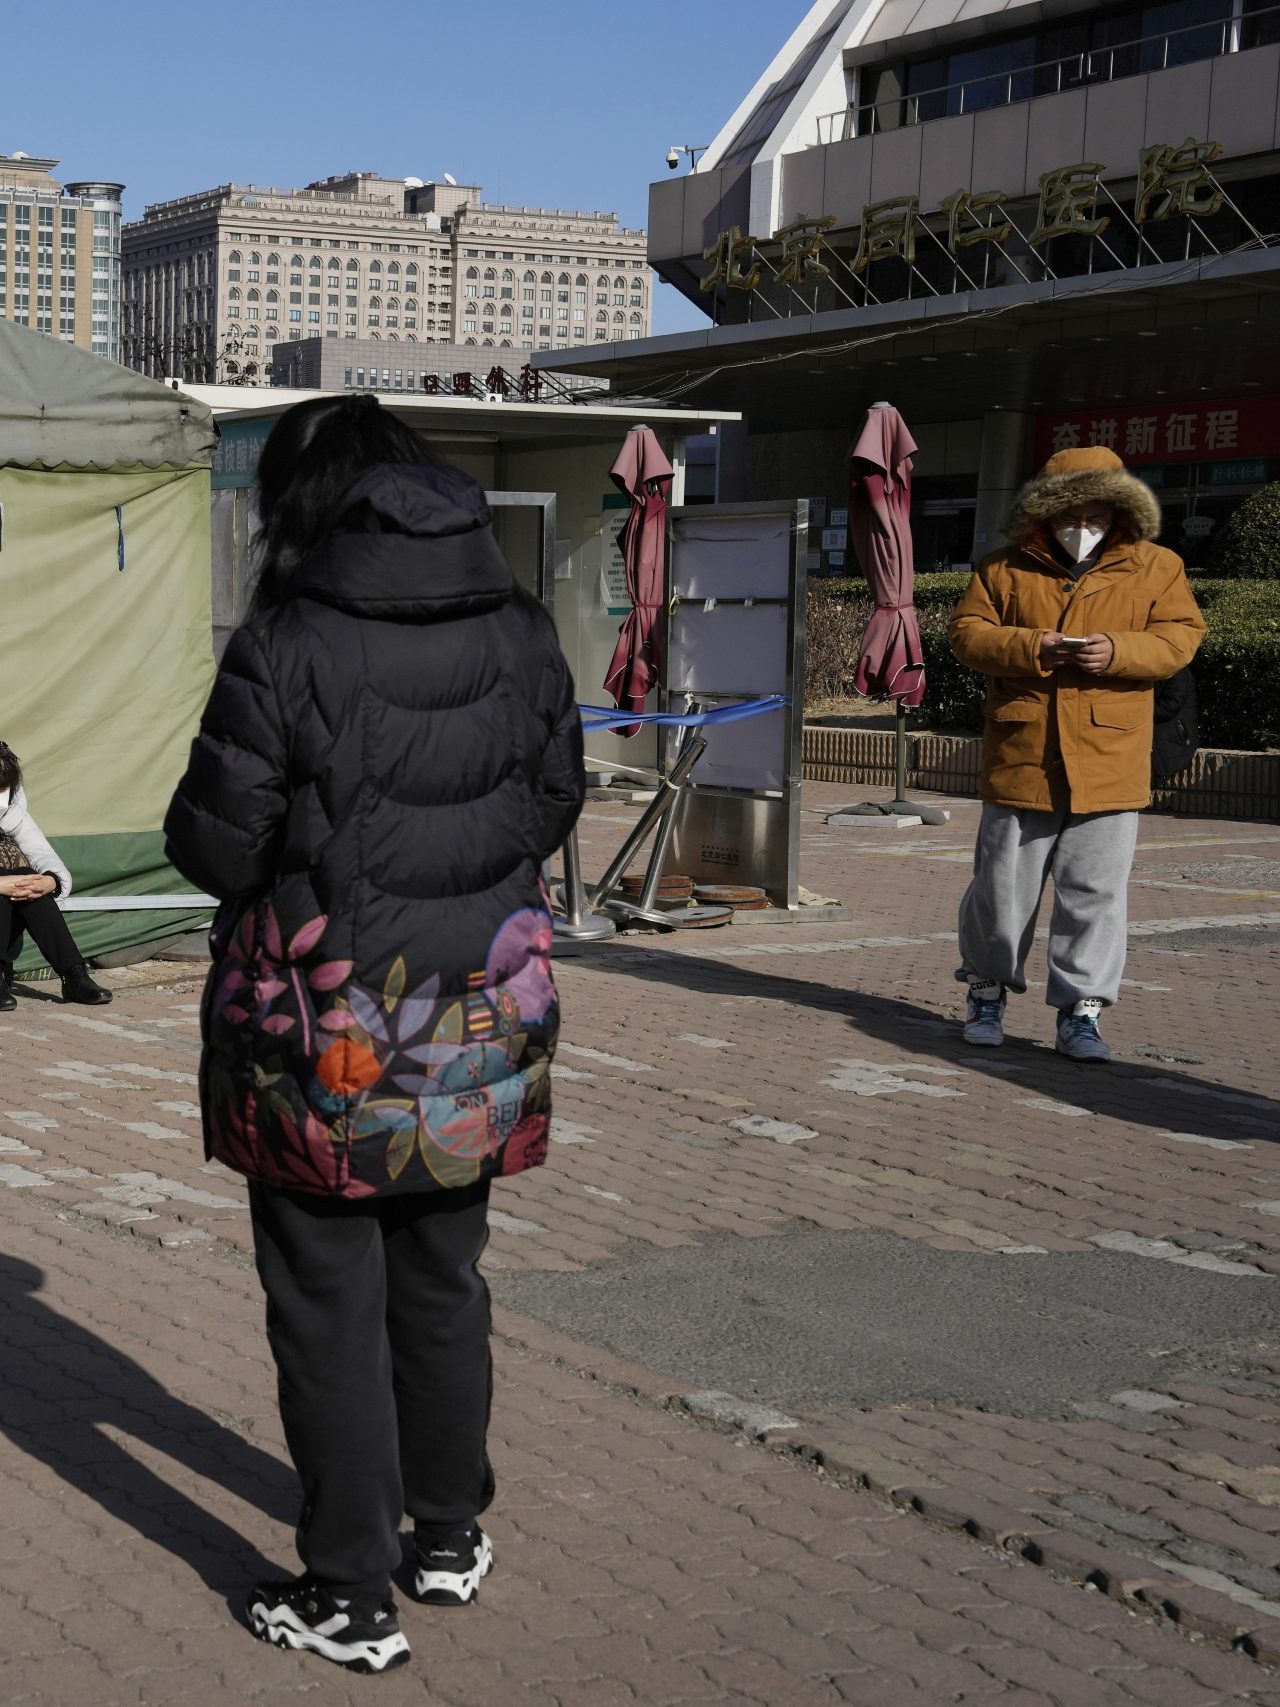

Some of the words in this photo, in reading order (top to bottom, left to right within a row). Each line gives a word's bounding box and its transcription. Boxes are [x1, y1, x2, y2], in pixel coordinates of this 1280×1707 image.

[700, 136, 1224, 293] 北京同仁医院
[1051, 409, 1239, 455] 奋进新征程
[213, 437, 267, 474] 毒核酸检
